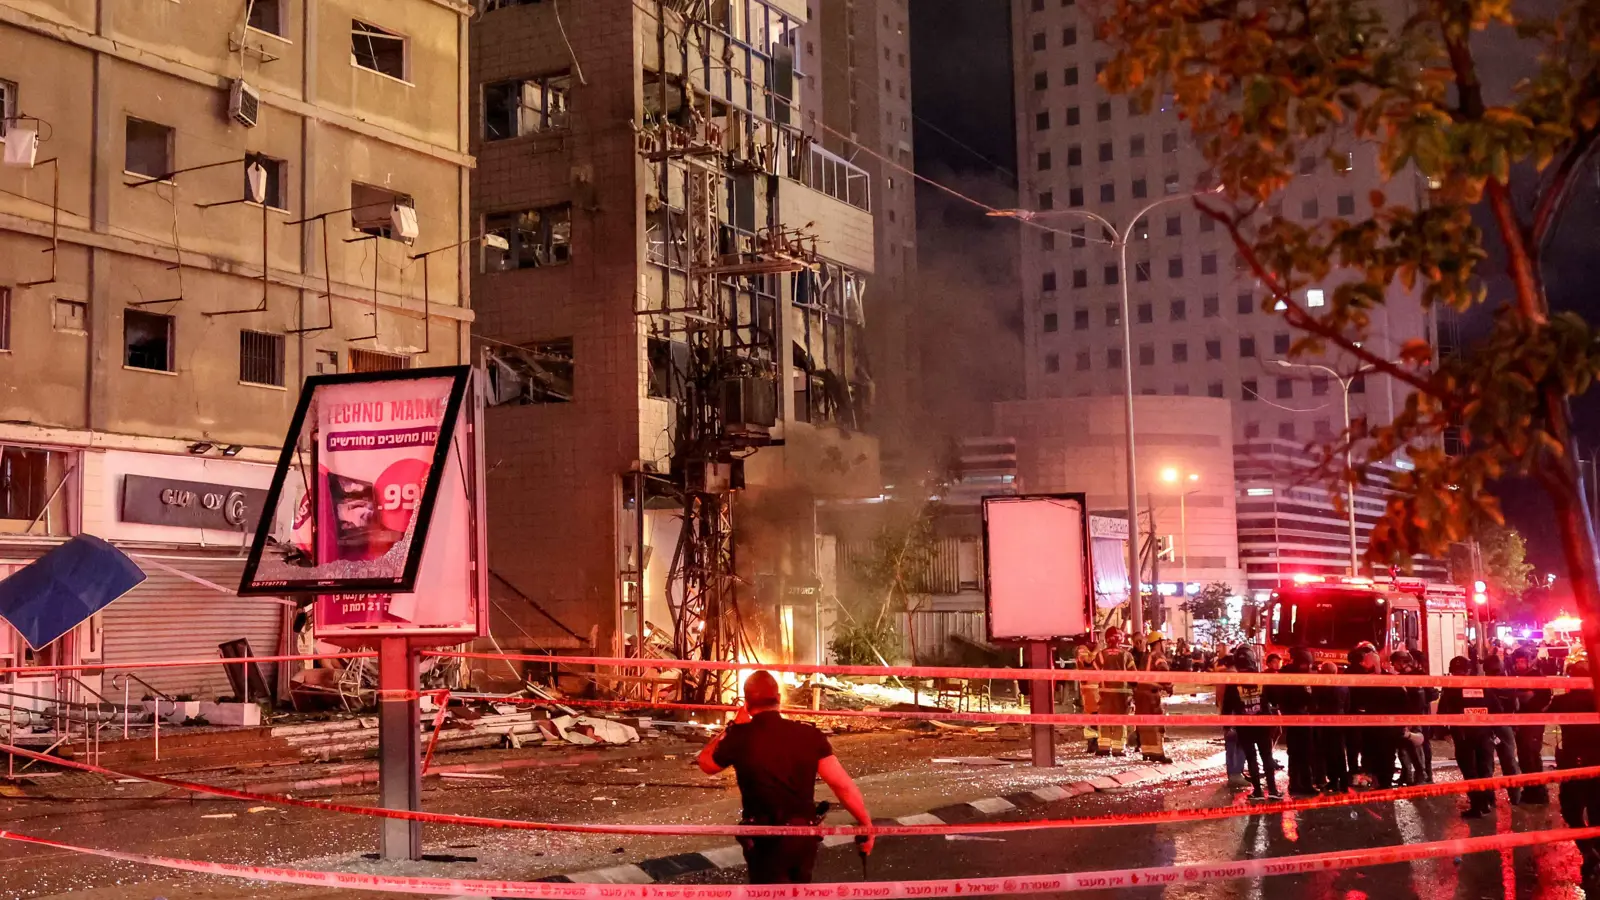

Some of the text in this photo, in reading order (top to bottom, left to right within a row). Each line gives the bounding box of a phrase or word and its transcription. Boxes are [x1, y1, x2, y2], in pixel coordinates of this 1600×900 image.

[328, 397, 445, 424] TECHNO MARK
[330, 430, 438, 447] גוון מחשבים מחודשים
[367, 602, 380, 611] 21
[1263, 863, 1295, 874] מעבר
[1076, 867, 1246, 888] משטרת ישראל אין מעבר
[745, 886, 890, 898] משטרת ישראל אין מעבר
[905, 880, 1061, 895] משטרת ישראל אין מעבר
